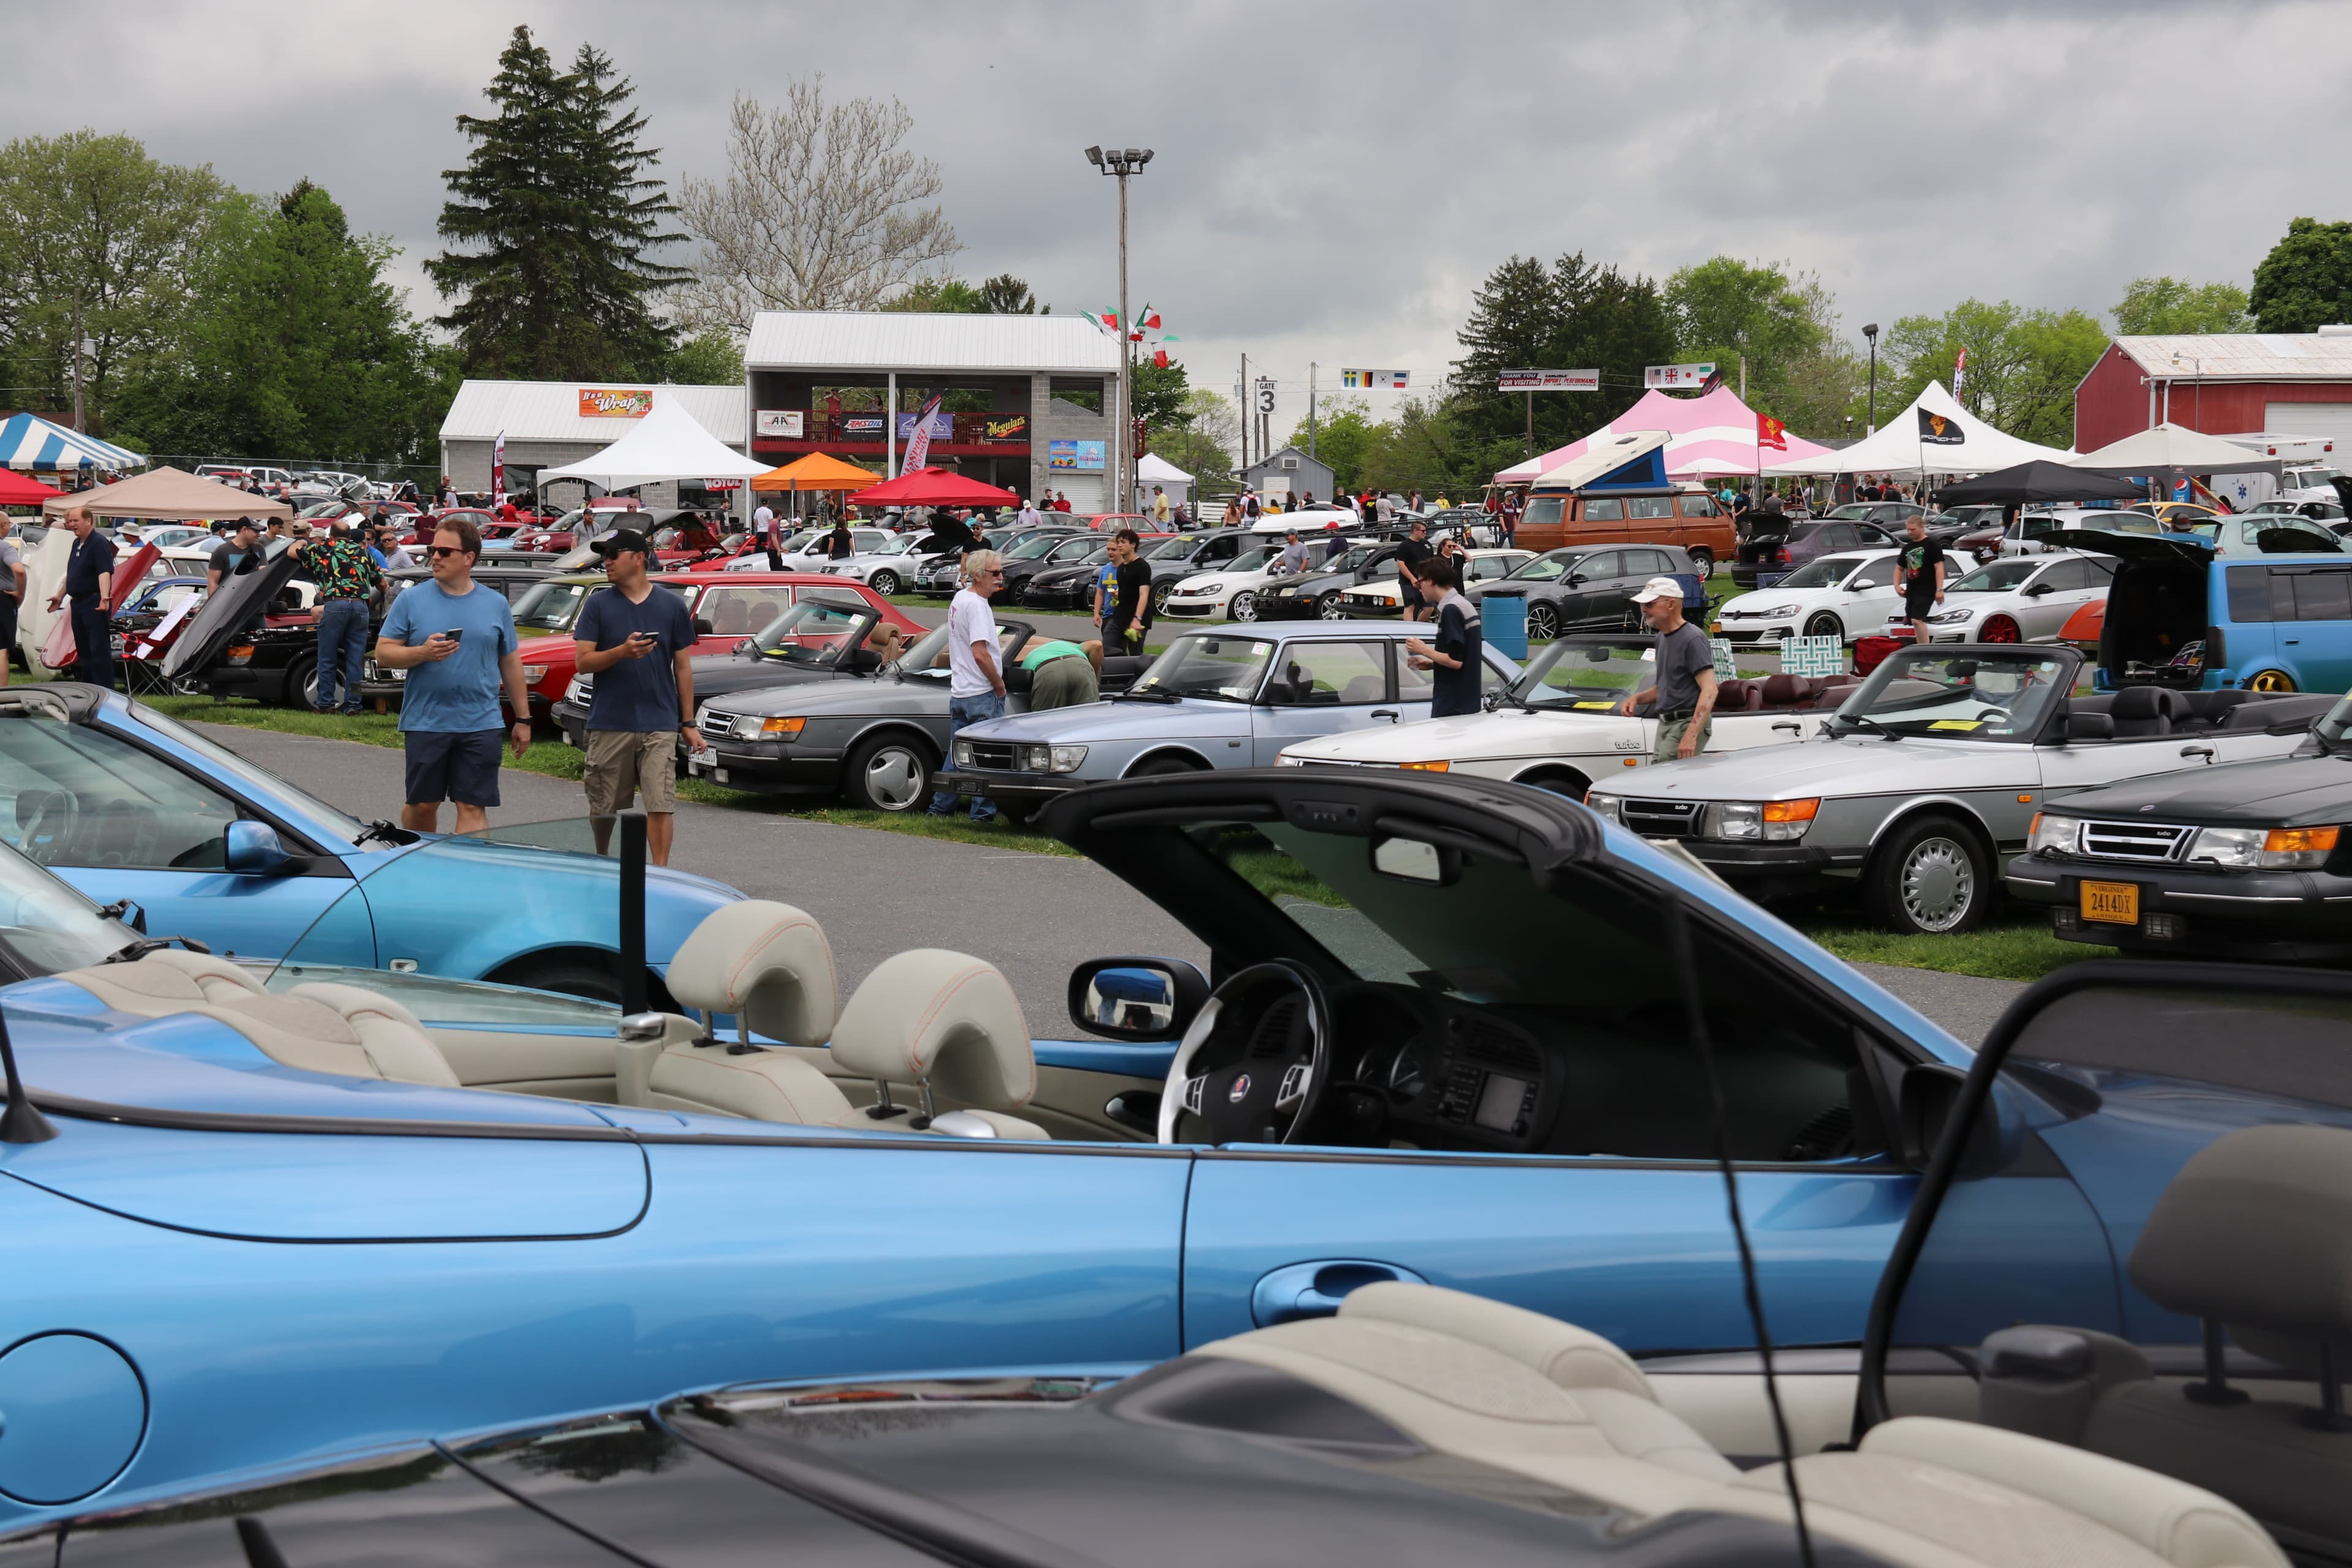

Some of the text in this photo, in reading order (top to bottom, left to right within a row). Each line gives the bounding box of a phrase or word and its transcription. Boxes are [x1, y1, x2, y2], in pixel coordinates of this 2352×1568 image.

[582, 391, 596, 401] It's
[595, 394, 636, 412] Wrap
[1260, 390, 1275, 413] 3
[845, 420, 882, 428] AMSOIL
[987, 416, 1025, 437] Meguiar's
[704, 478, 742, 490] MOTUL
[1615, 739, 1642, 749] turbo
[2091, 892, 2131, 913] 2414DX
